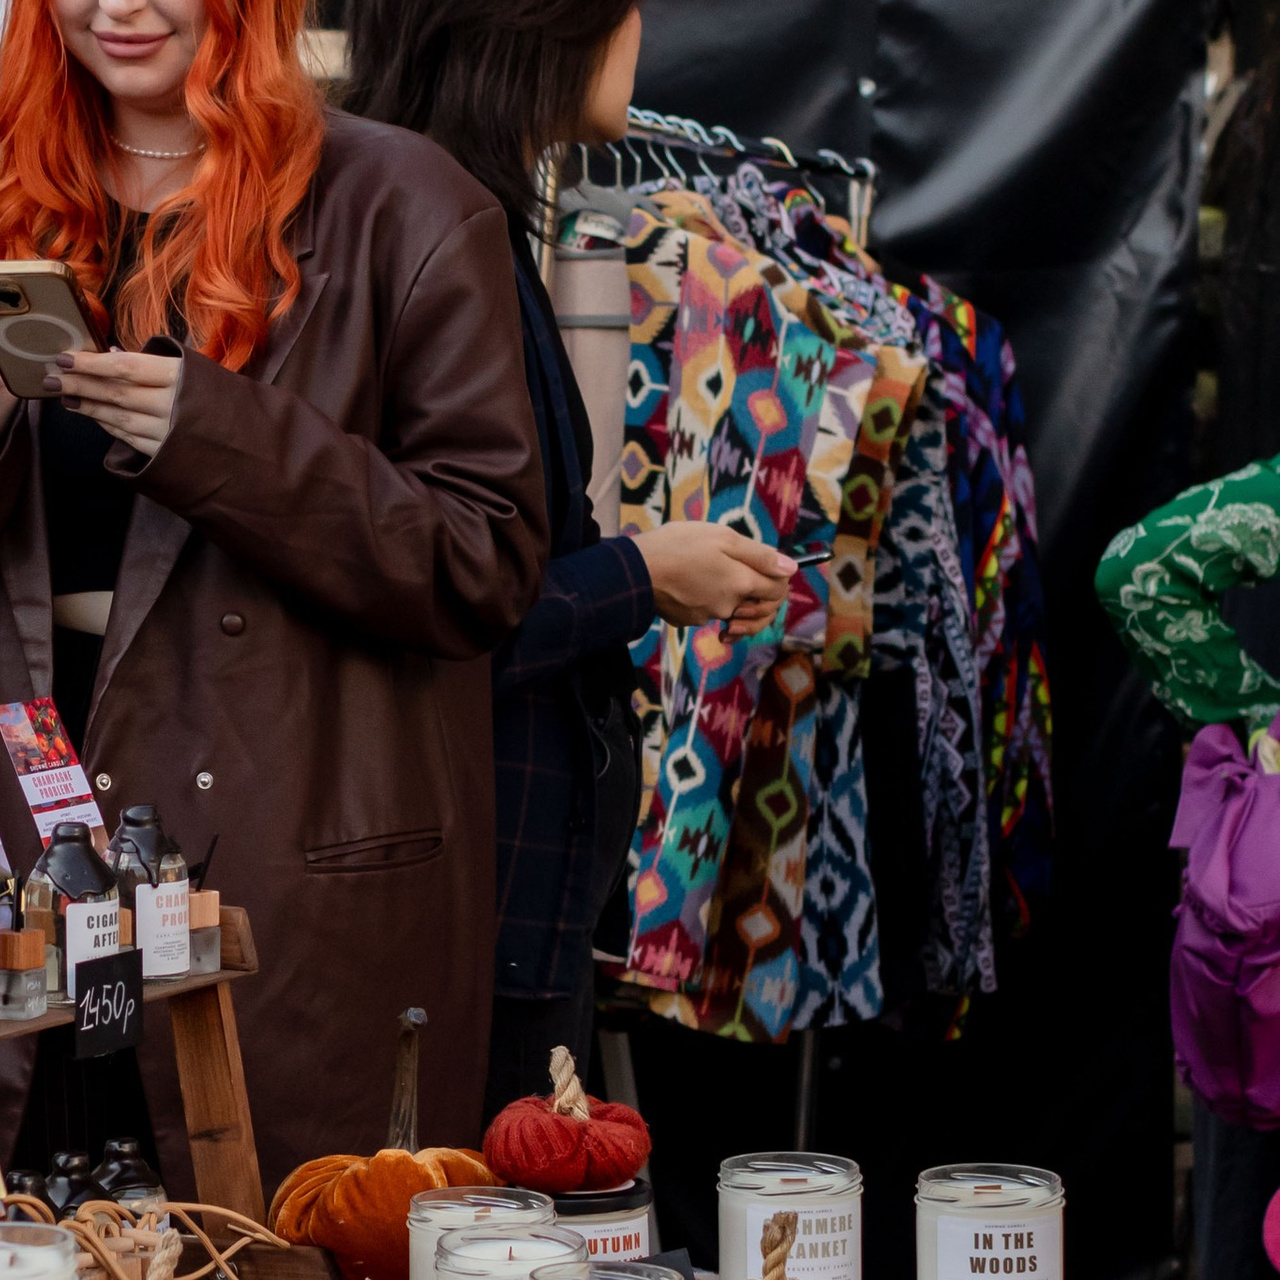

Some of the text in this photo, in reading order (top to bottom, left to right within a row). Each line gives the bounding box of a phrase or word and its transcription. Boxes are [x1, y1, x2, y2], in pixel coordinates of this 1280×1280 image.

[32, 770, 73, 788] CHAMPAGNE
[39, 782, 75, 799] PROBLEMS
[796, 1213, 853, 1236] HMERE
[587, 1231, 641, 1256] UTUMN
[974, 1231, 1034, 1250] IN THE
[969, 1255, 1038, 1274] WOODS
